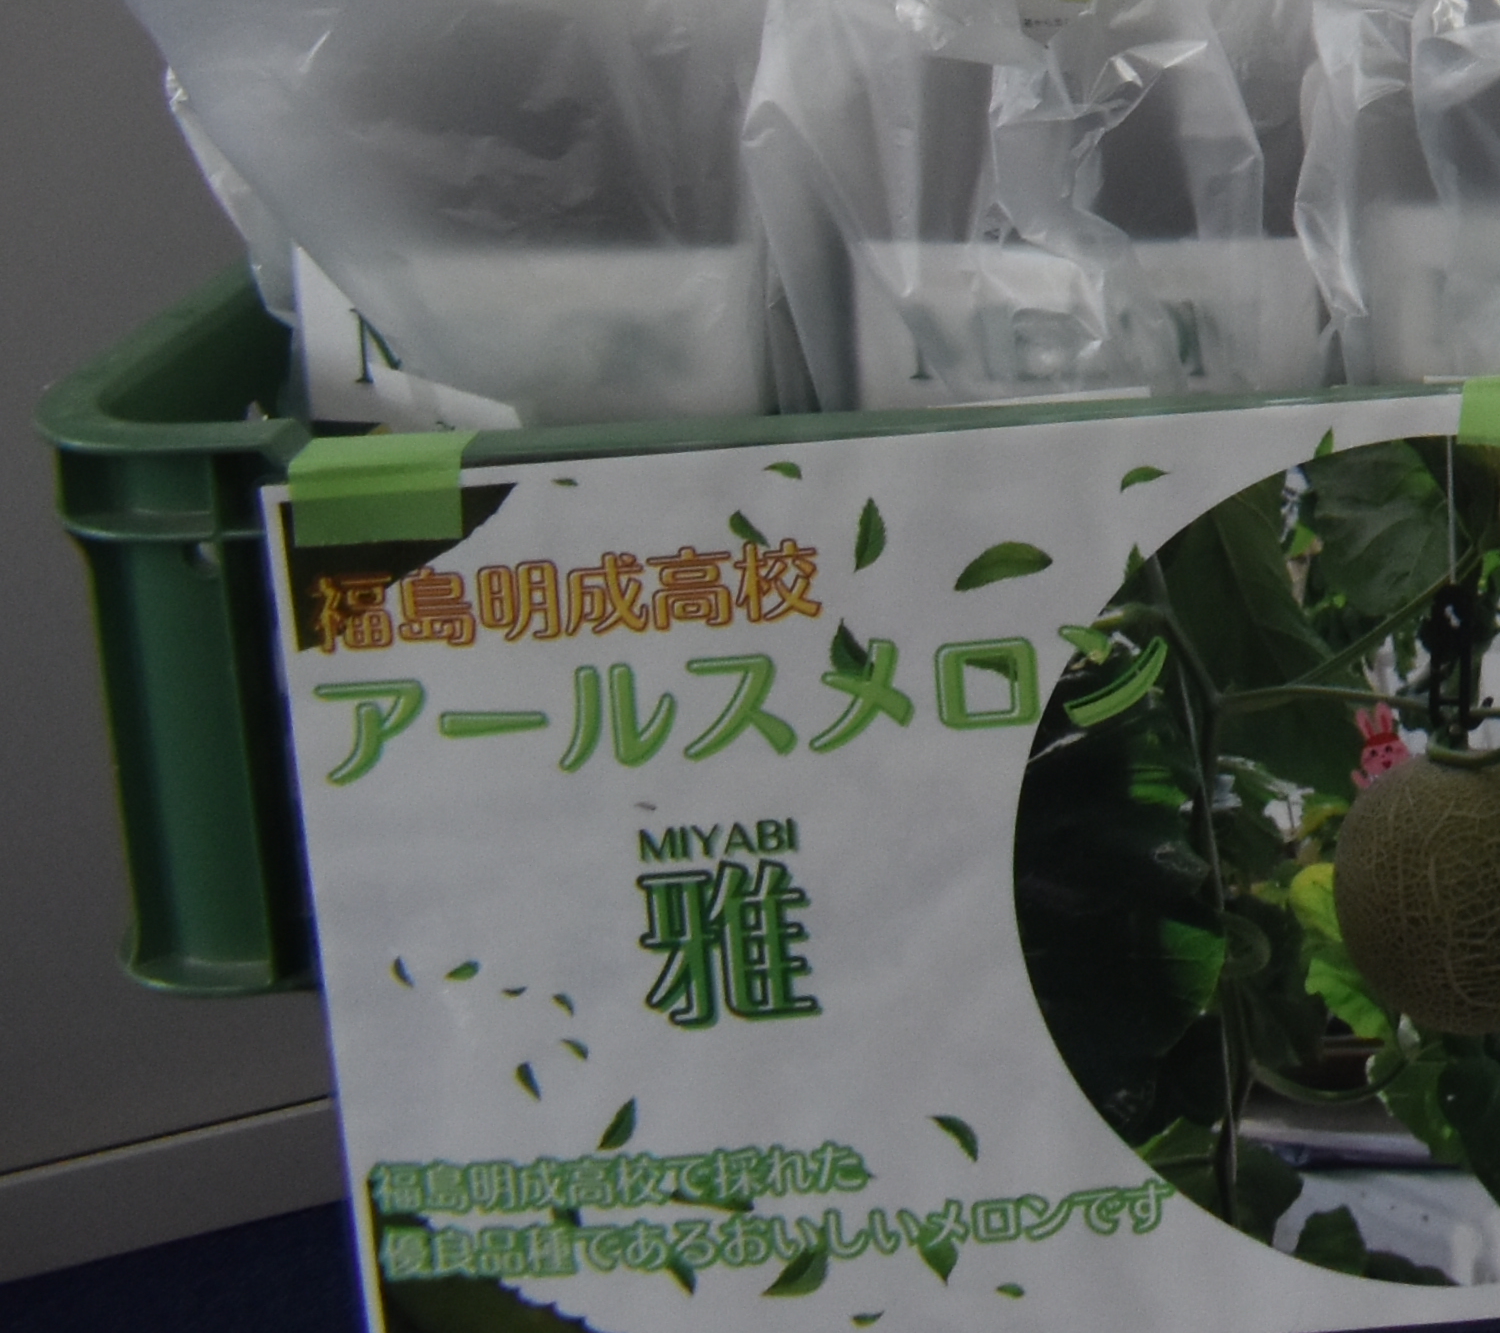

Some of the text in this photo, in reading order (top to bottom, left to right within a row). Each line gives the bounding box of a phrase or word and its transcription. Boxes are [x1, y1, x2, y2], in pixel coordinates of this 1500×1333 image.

[313, 540, 823, 654] 福島明成高校
[313, 625, 1168, 787] アールスメロン
[637, 817, 800, 863] MIYABI
[636, 858, 823, 1031] 雅
[374, 1141, 872, 1215] 福島明成高校で採れた
[380, 1181, 1178, 1281] 優良品種であるおいしいメロンです
